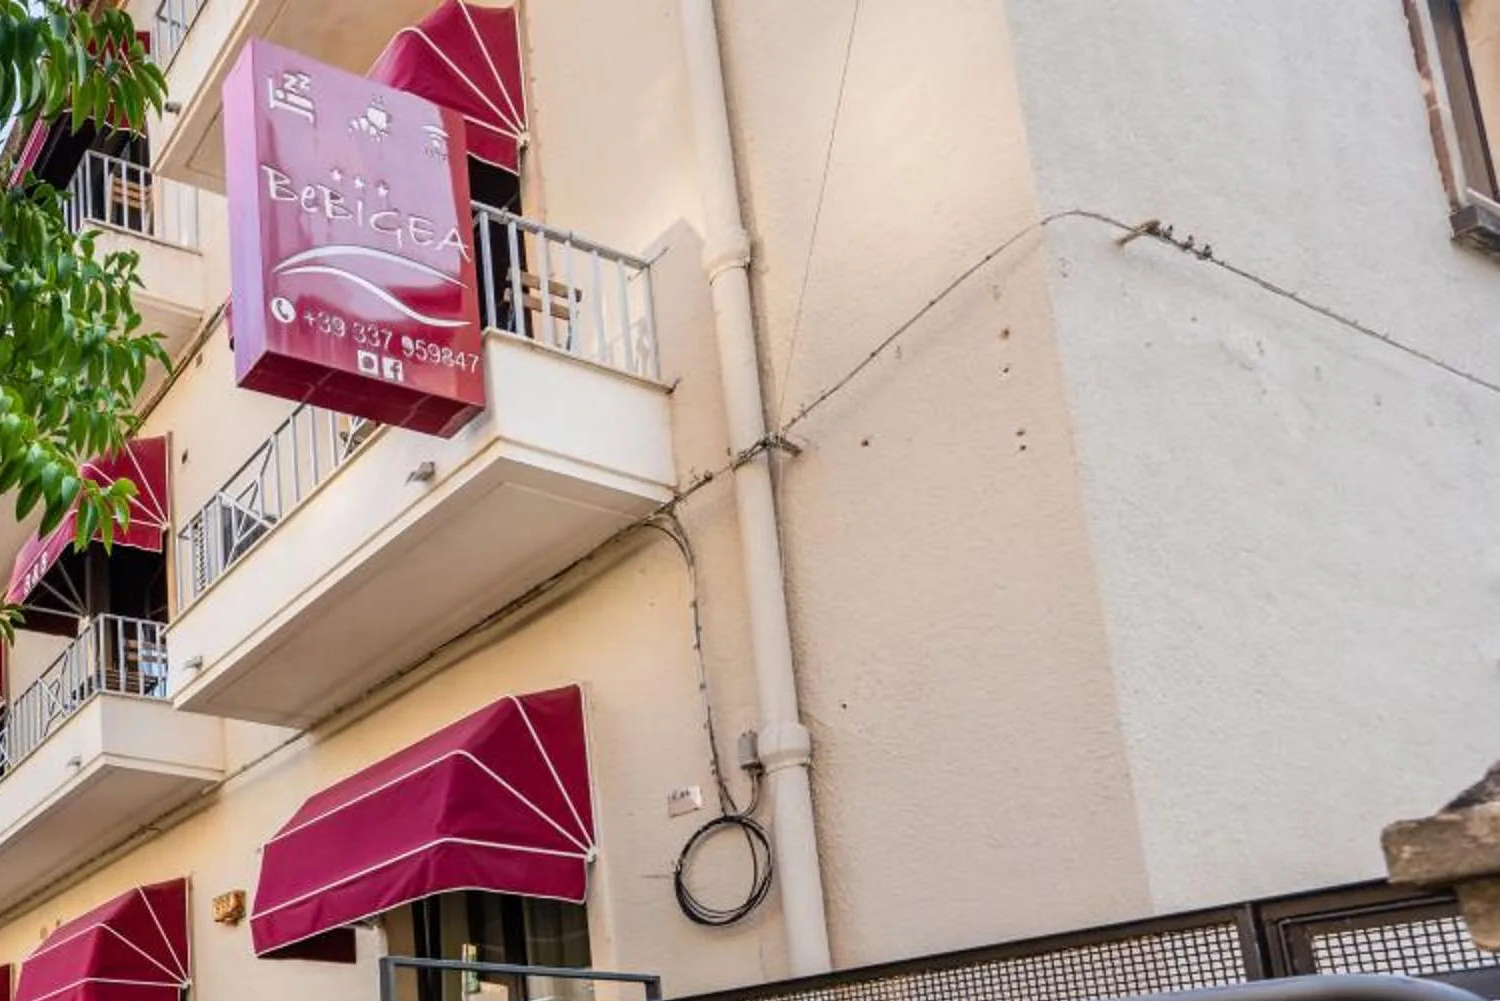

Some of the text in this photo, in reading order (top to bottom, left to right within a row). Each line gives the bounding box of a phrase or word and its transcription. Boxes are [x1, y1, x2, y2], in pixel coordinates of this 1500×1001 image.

[303, 311, 480, 373] +39 337 959847
